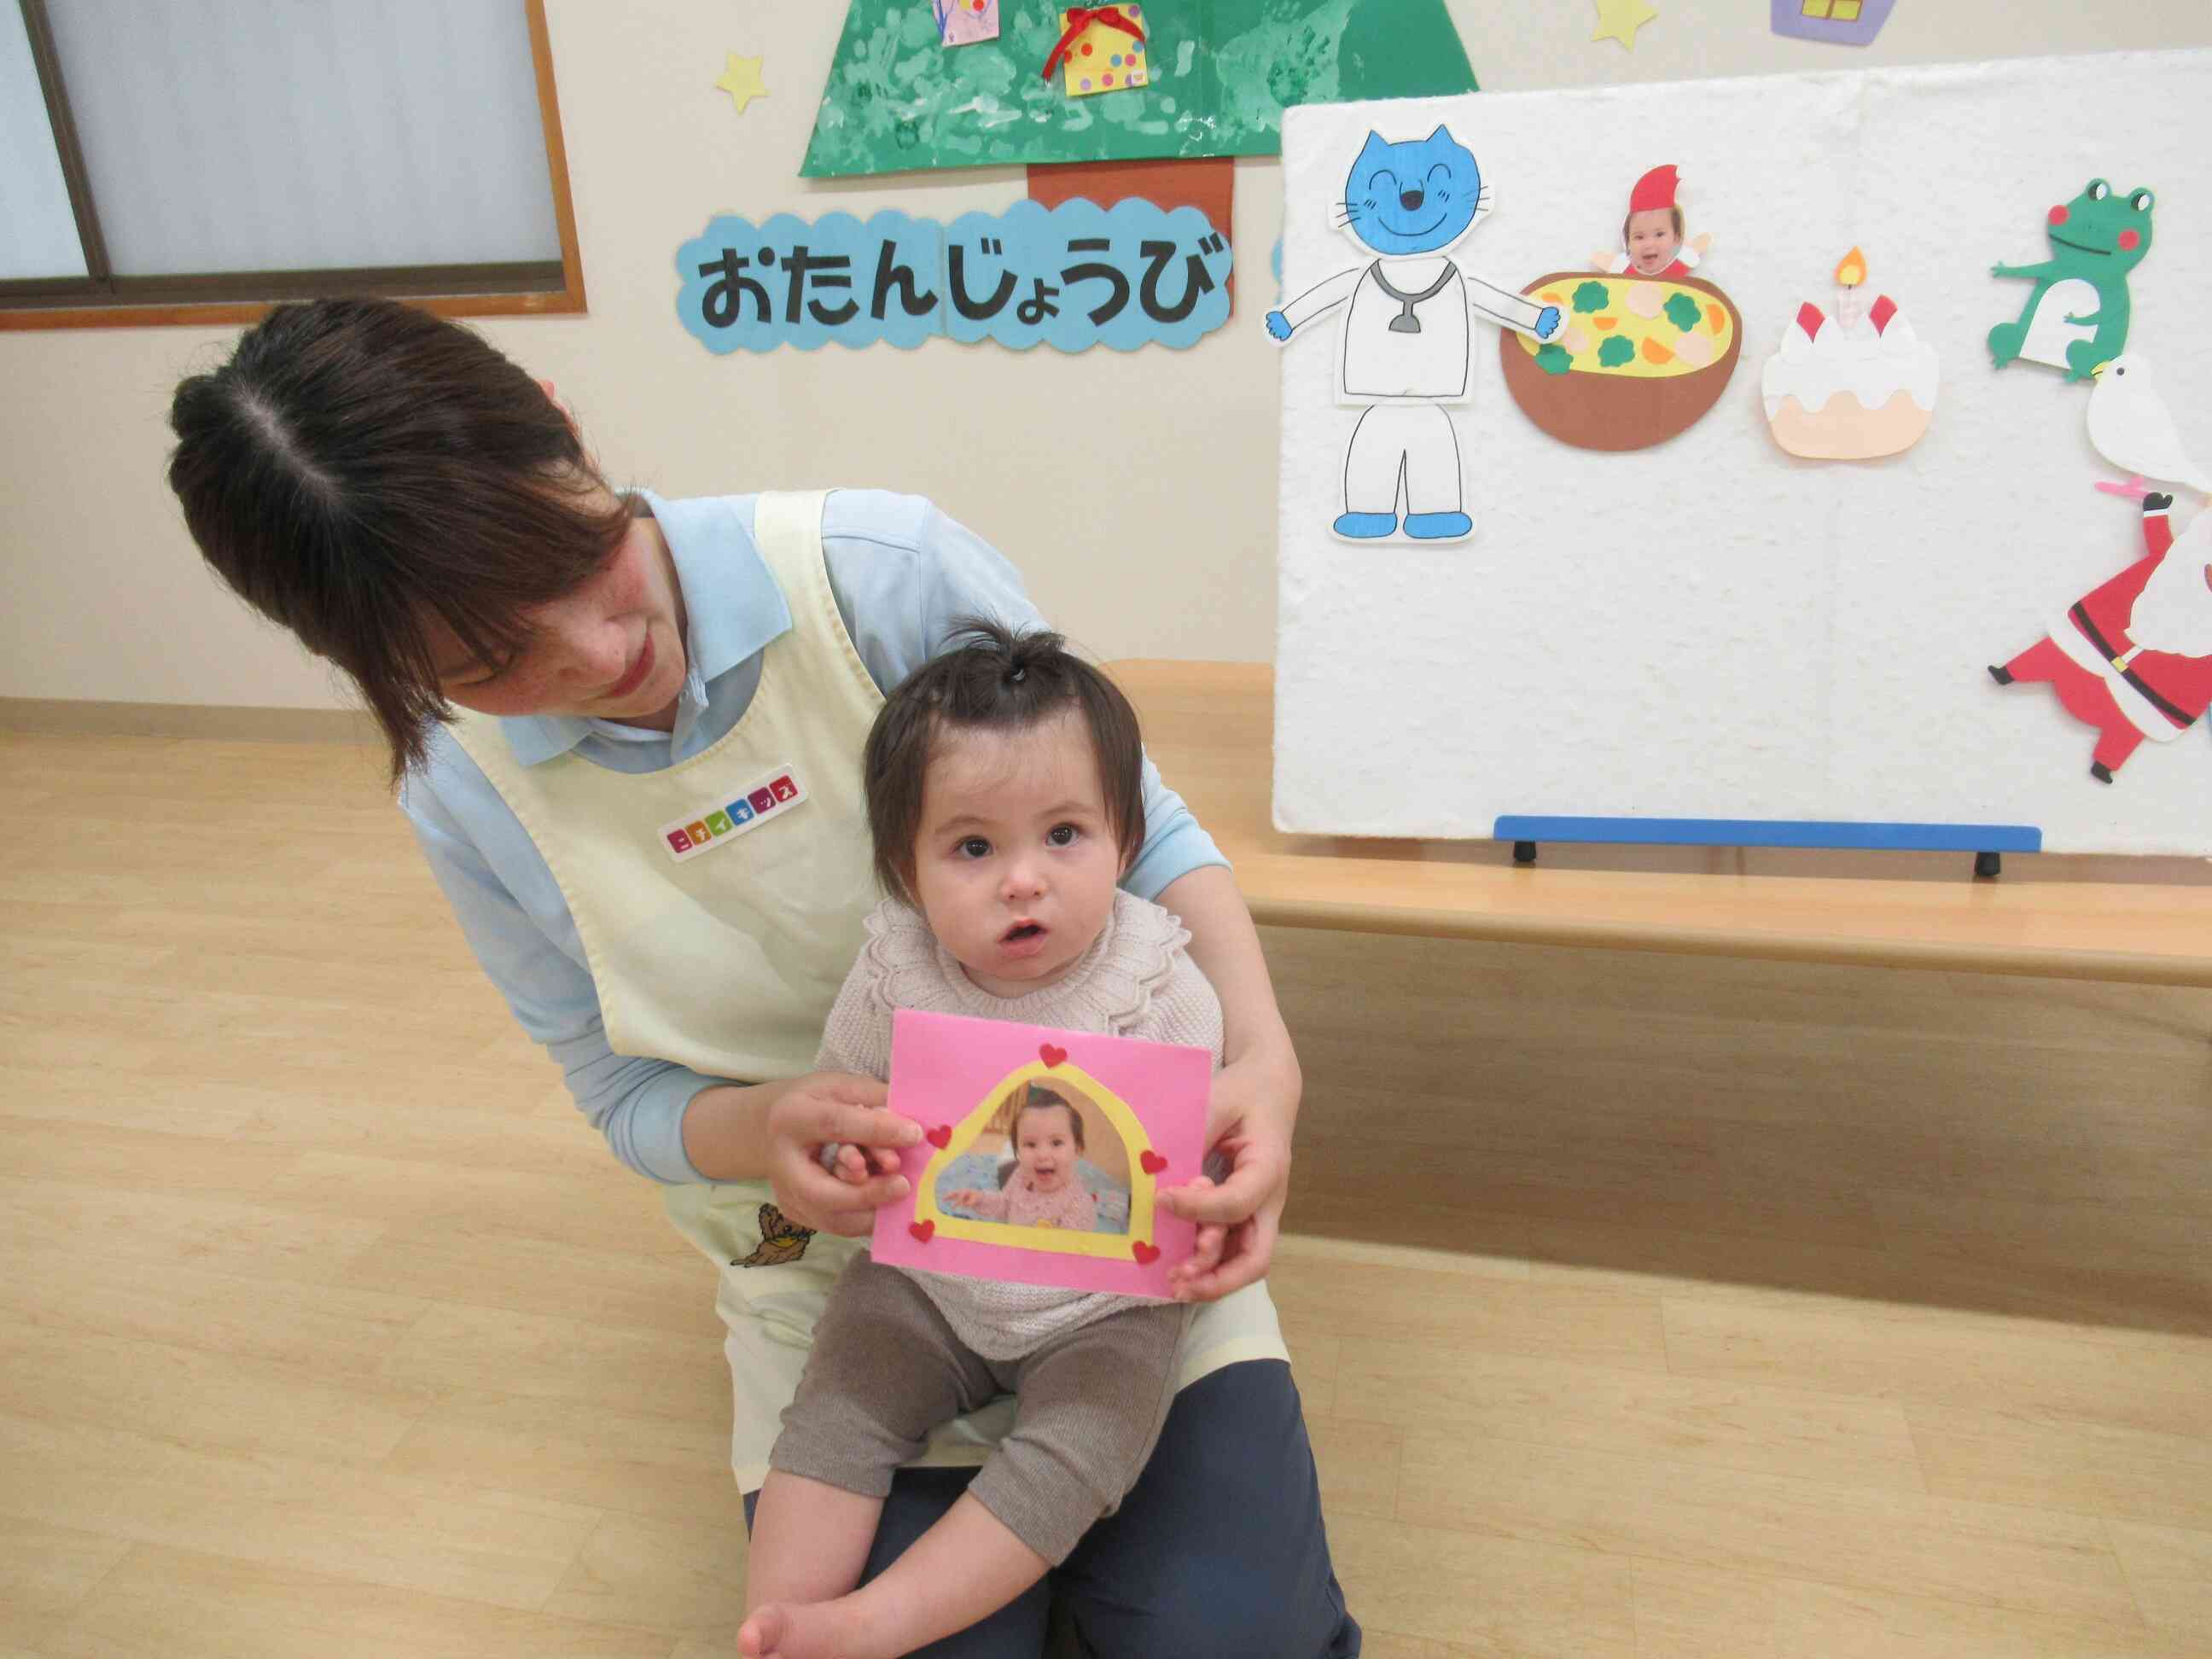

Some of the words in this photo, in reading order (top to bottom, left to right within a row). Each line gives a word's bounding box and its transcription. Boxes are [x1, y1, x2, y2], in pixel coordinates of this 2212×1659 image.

[698, 237, 1224, 328] おたんじょうび
